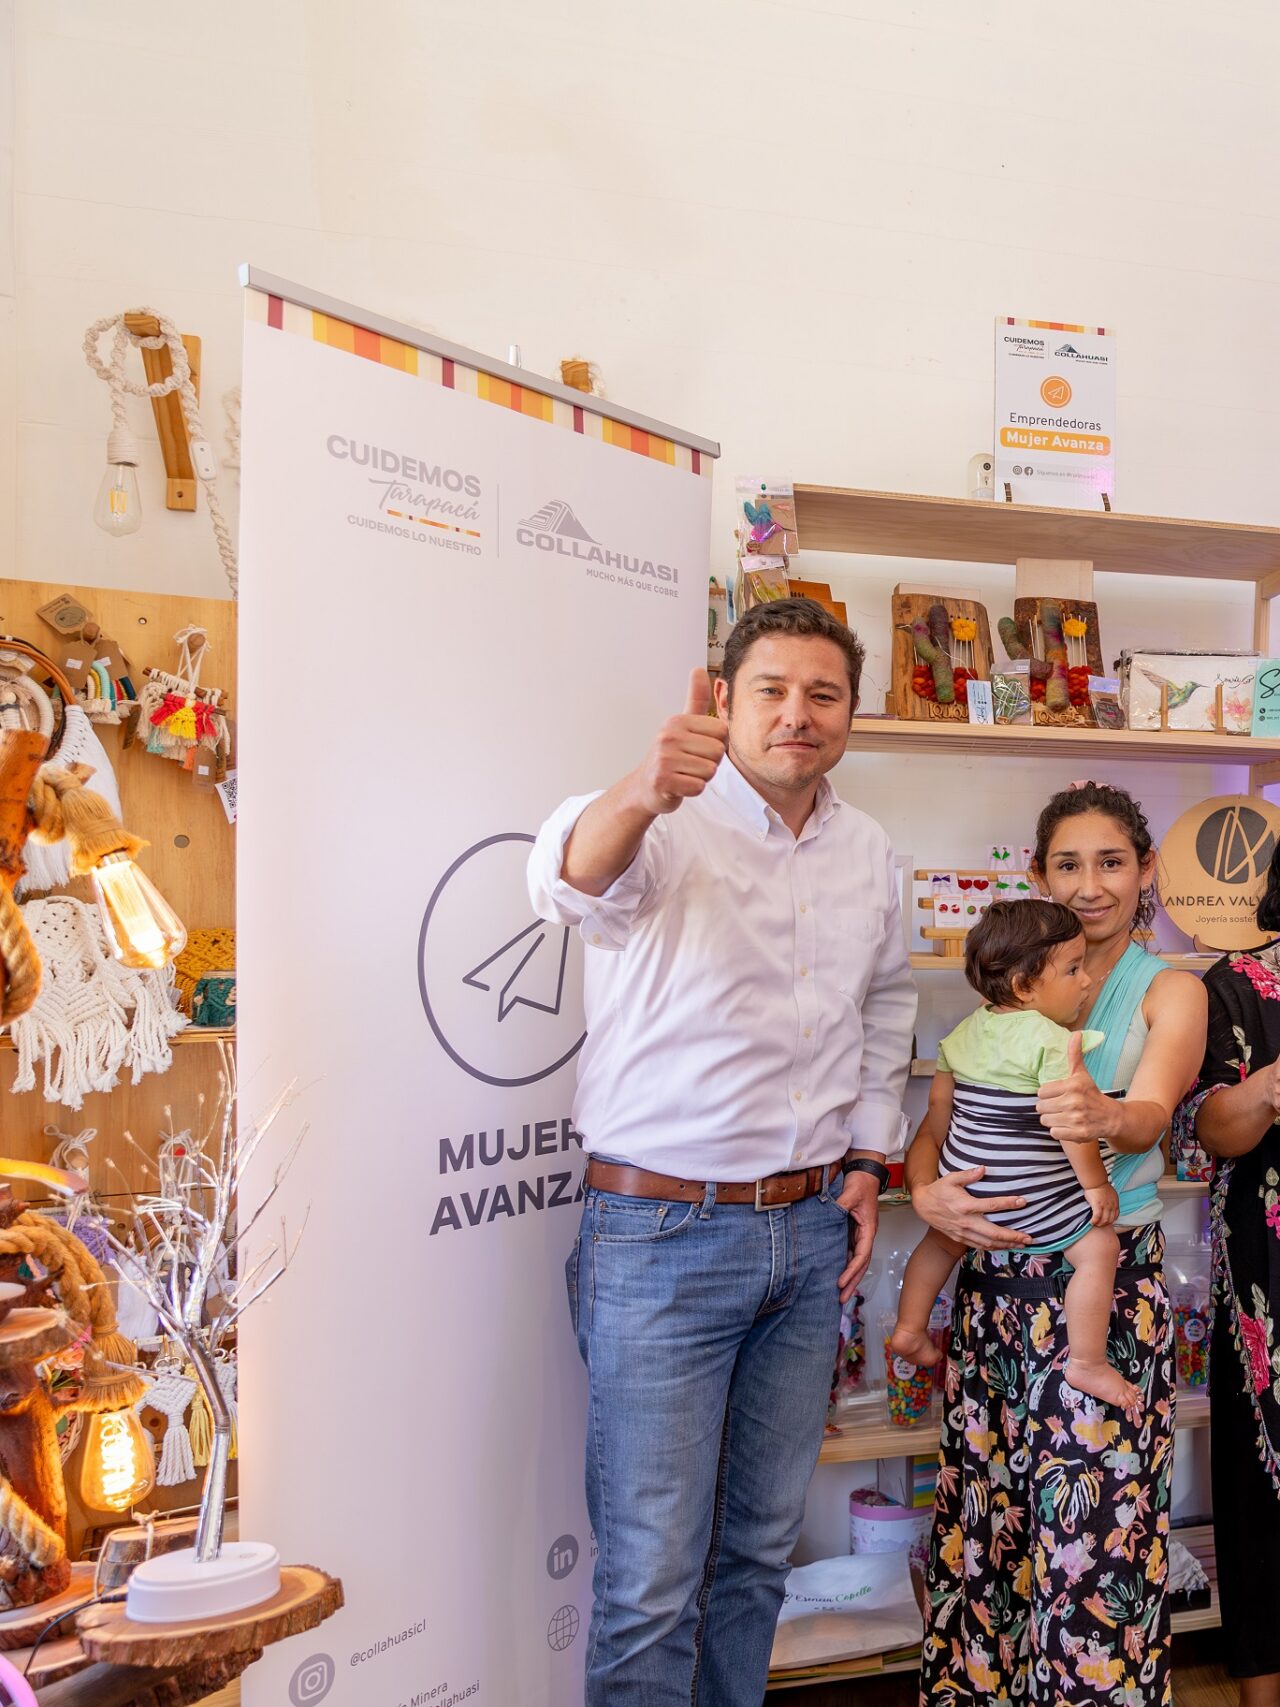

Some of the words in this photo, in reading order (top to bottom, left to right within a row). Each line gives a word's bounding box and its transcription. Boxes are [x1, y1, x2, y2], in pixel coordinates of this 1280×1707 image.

[1003, 336, 1045, 346] CUIDEMOS
[1054, 352, 1108, 361] COLLAHUASI
[1009, 412, 1102, 431] Emprendedoras
[1006, 431, 1048, 449] Mujer
[1052, 436, 1104, 451] Avanza
[326, 434, 482, 498] CUIDEMOS
[368, 477, 481, 521] Tarapacá
[347, 514, 411, 539] CUIDEMOS
[412, 531, 427, 543] LO
[429, 535, 482, 556] NUESTRO
[516, 528, 679, 584] COLLAHUASI
[586, 568, 616, 583] MUCHO
[617, 576, 634, 588] MÁS
[635, 581, 652, 592] QUE
[653, 585, 679, 598] COBRE
[1165, 896, 1225, 907] ANDREA
[1195, 914, 1227, 927] Joyería
[349, 1618, 427, 1667] @collahuasicl
[410, 1682, 448, 1707] Minera
[428, 1680, 480, 1707] llahuasi
